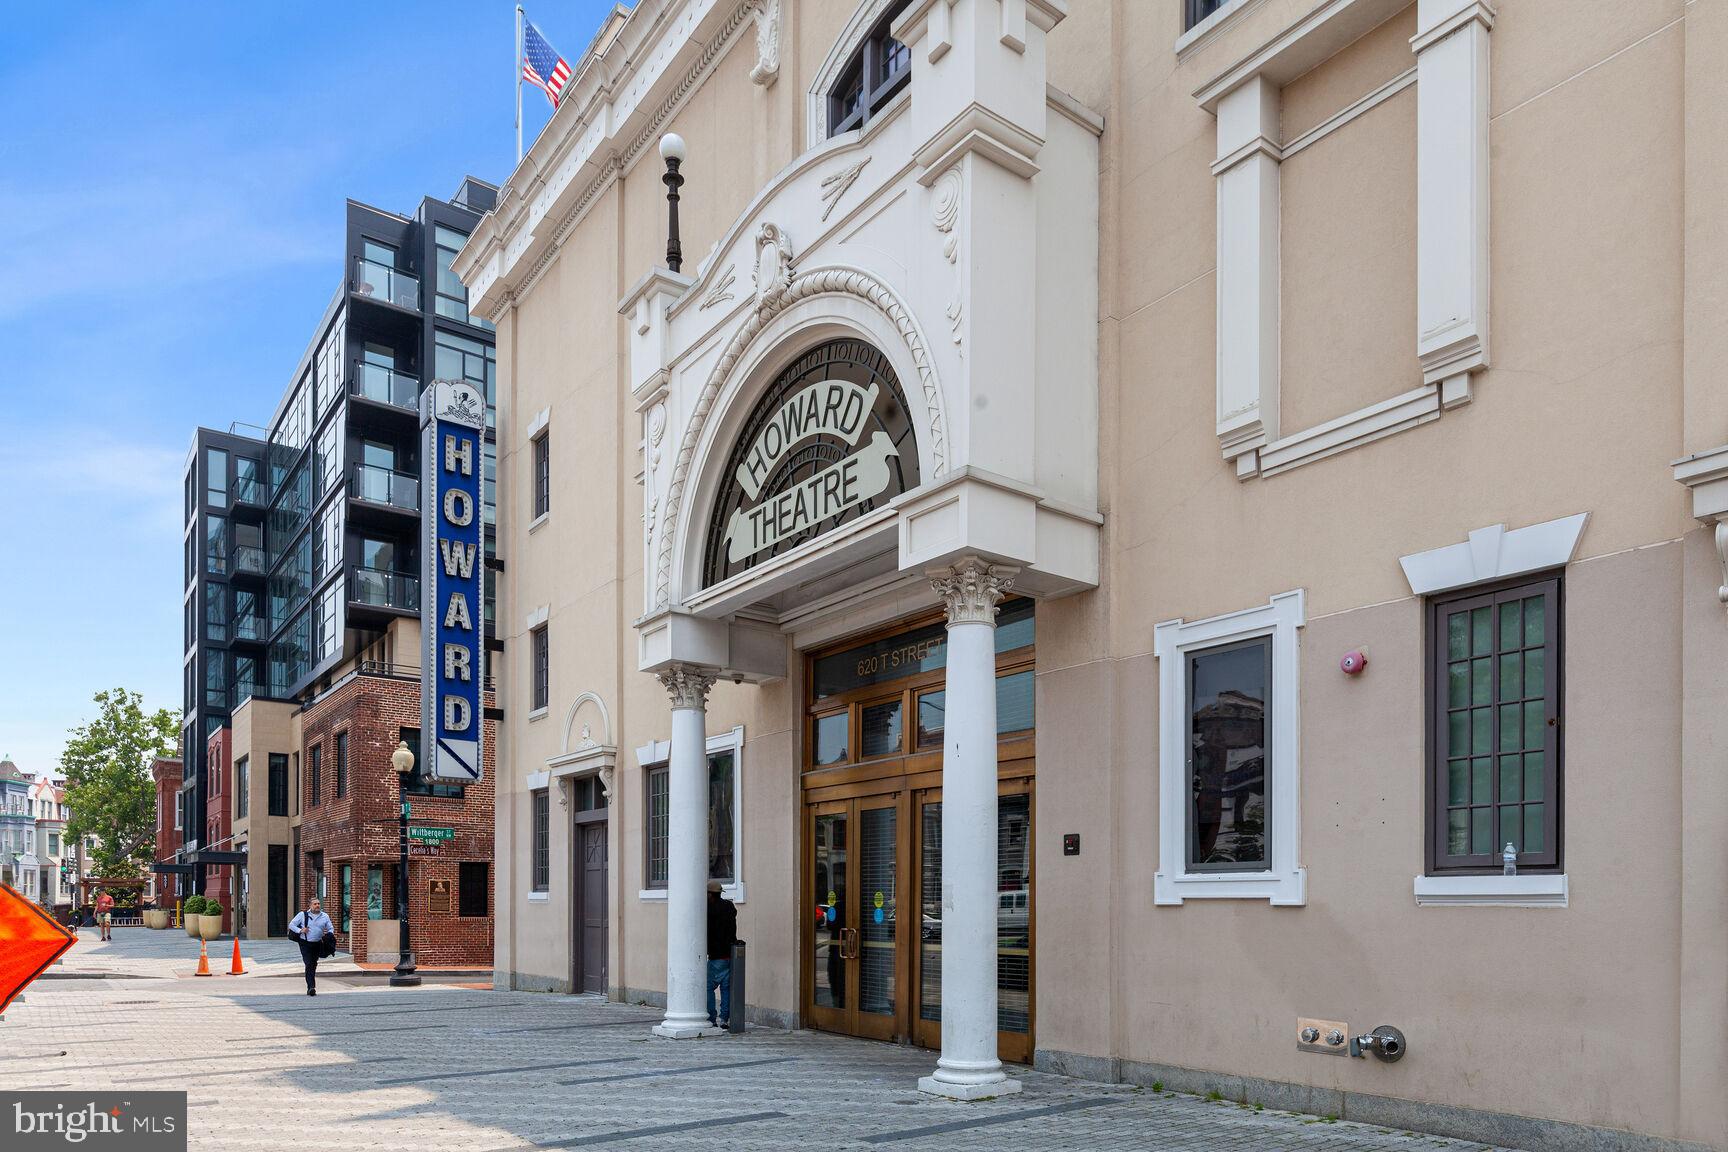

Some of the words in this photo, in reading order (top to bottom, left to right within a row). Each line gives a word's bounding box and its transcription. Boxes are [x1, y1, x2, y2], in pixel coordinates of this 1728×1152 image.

[746, 385, 864, 488] HOWARD
[749, 458, 859, 548] THEATRE
[440, 434, 477, 732] HOWARD
[857, 658, 878, 676] 620
[880, 653, 889, 670] T
[891, 637, 944, 667] STREET
[411, 828, 444, 838] Wiltberger
[430, 846, 439, 856] Way
